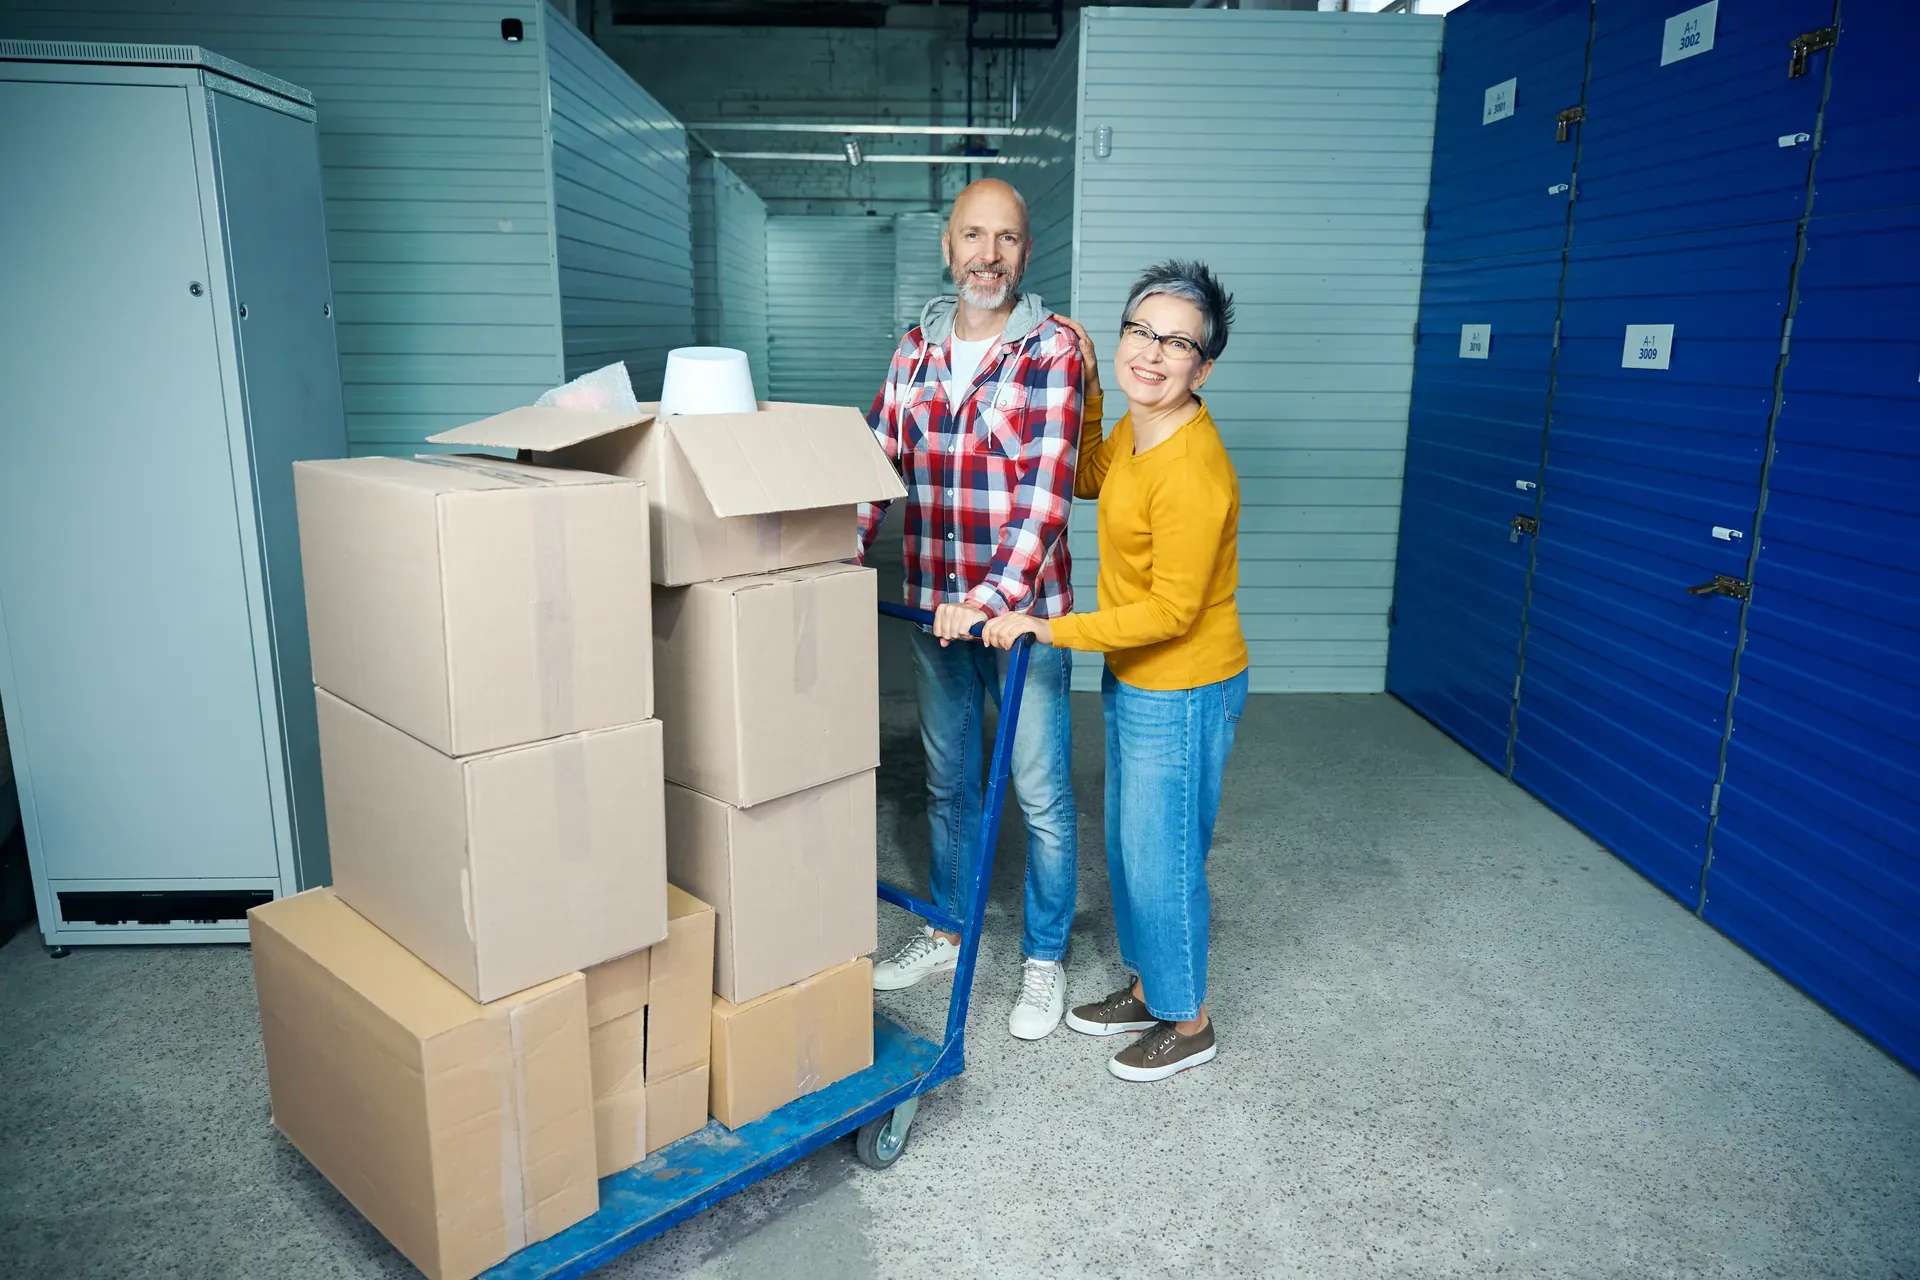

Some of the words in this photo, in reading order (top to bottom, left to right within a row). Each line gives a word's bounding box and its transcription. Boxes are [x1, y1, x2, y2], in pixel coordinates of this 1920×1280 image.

[1683, 19, 1698, 36] A-1
[1679, 32, 1701, 51] 3002
[1642, 335, 1655, 347] A-1
[1638, 348, 1658, 360] 3009
